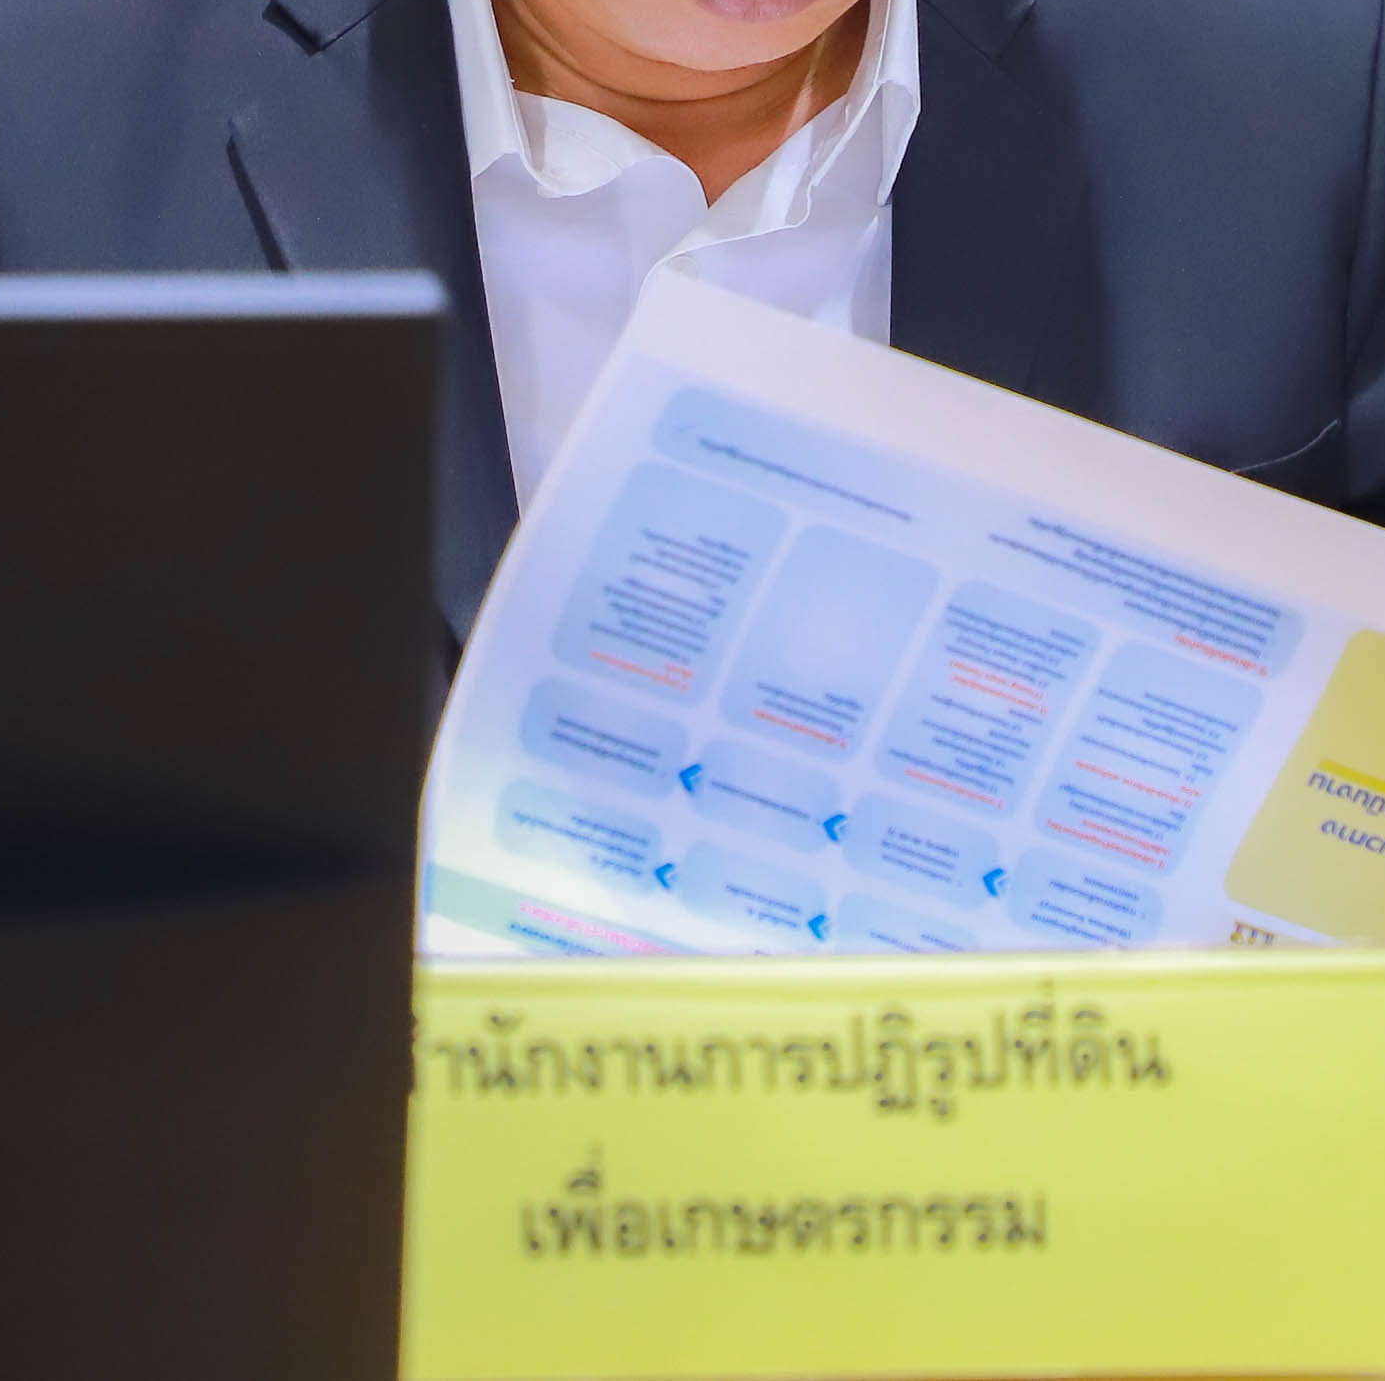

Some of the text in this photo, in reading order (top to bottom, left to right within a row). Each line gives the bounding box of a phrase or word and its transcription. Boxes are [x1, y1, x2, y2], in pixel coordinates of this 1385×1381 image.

[520, 1142, 1050, 1258] เพื่อเกษตรกรรม
